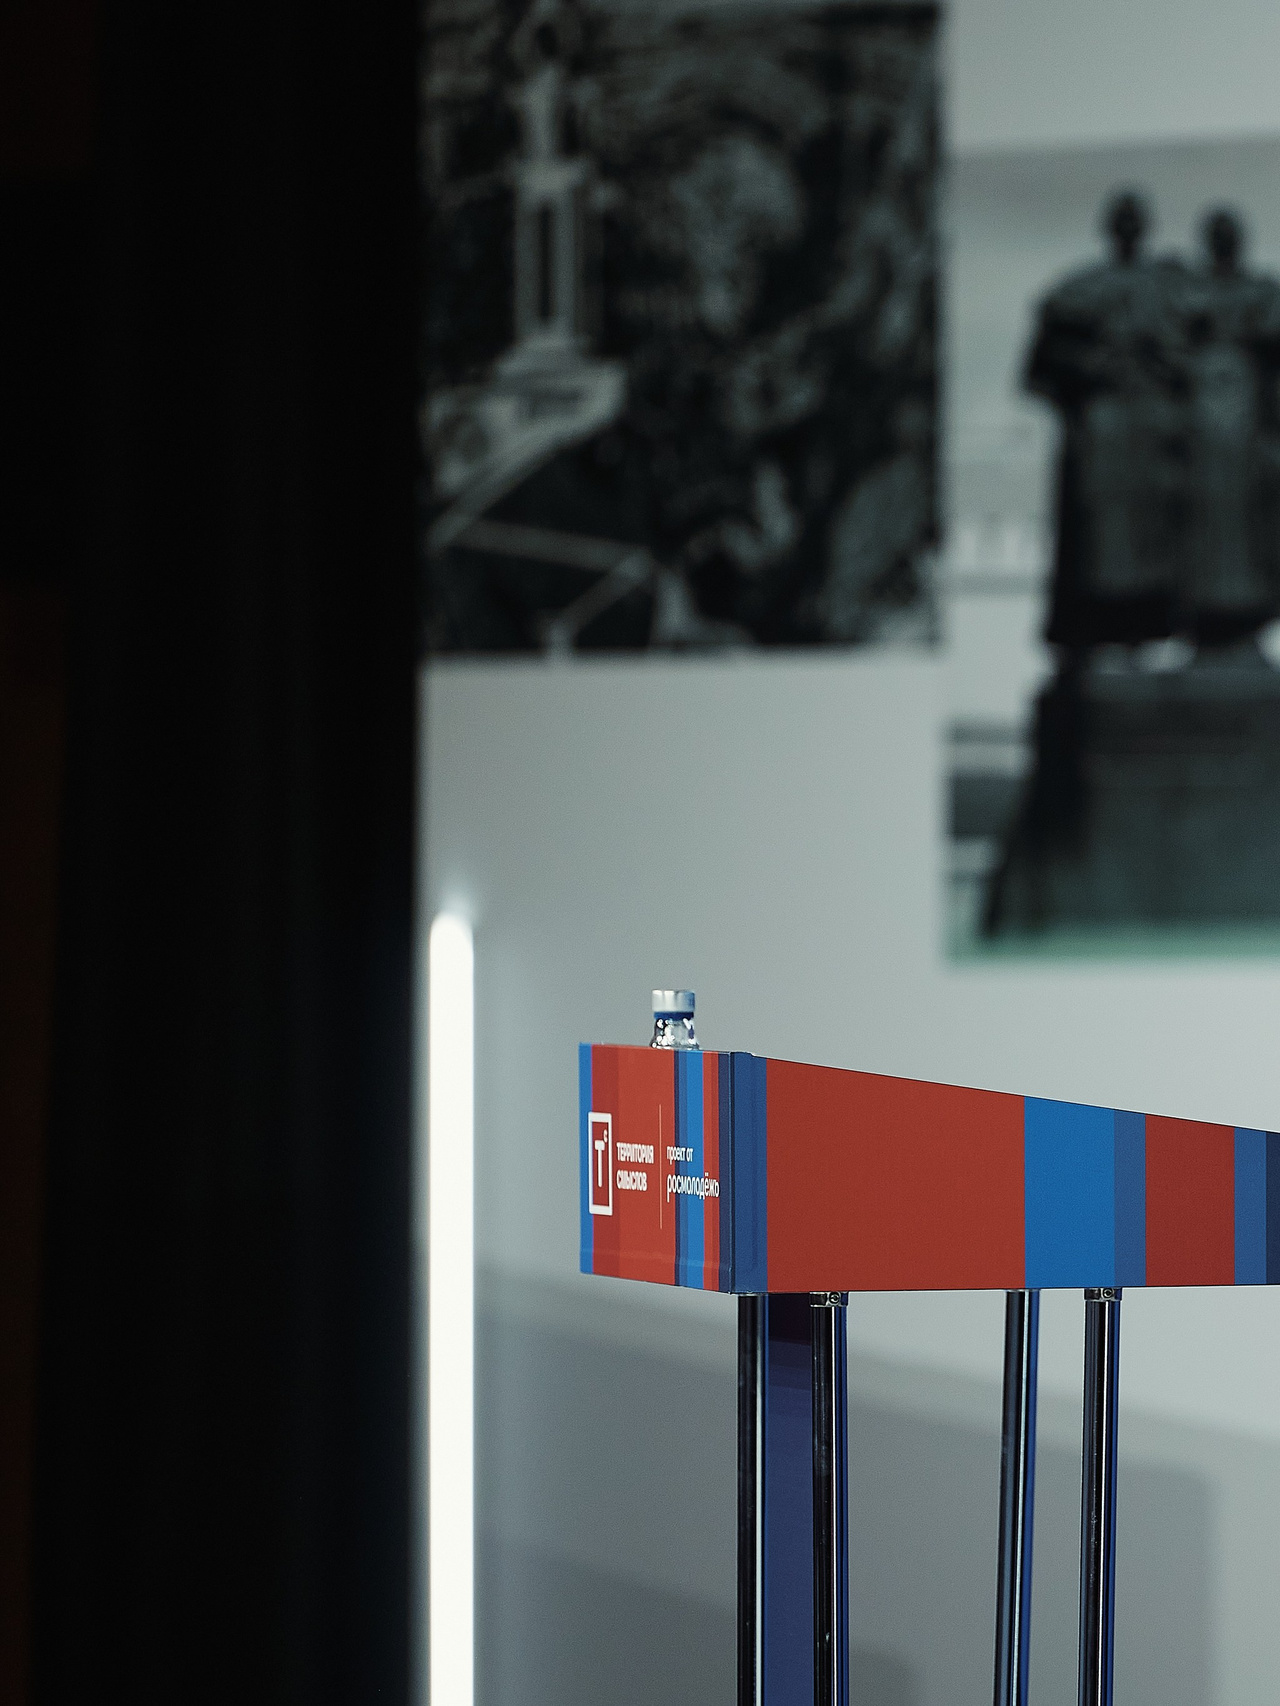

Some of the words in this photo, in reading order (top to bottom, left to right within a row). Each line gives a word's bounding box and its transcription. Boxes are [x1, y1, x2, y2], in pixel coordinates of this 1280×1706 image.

[616, 1142, 655, 1164] ТЕРРИТОРИЯ
[666, 1145, 685, 1166] проект
[686, 1147, 694, 1162] от
[616, 1169, 648, 1192] СМЫСЛОВ
[666, 1171, 720, 1203] росмолодёжь
